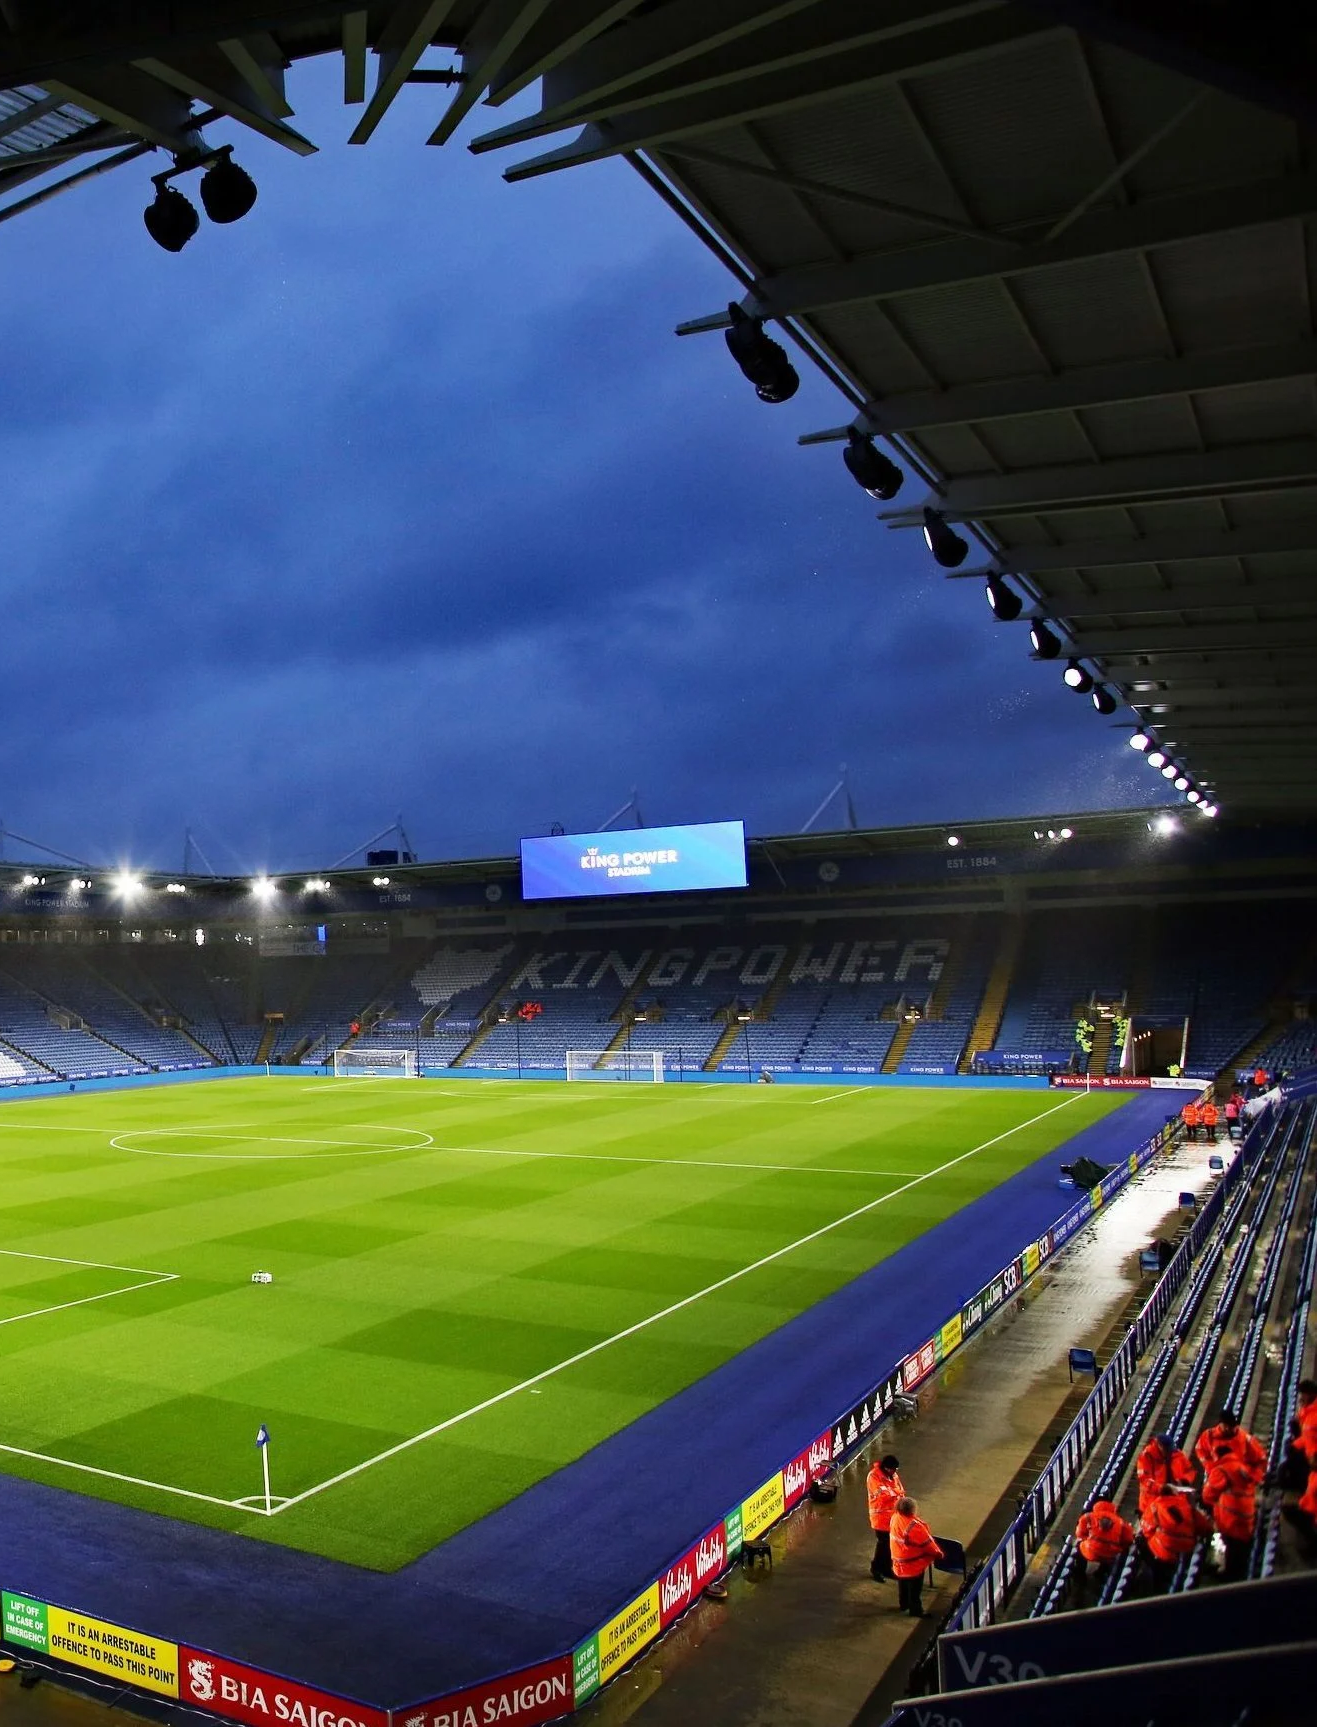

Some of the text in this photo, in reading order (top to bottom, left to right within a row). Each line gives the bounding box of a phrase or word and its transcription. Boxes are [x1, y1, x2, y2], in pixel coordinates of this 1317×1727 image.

[581, 850, 678, 869] KING POWER
[607, 866, 651, 877] STADIUM
[784, 1460, 807, 1499] Vitality
[695, 1533, 724, 1580] Vitality
[10, 1600, 40, 1617] LIFT OFF
[661, 1563, 692, 1614] Vitality
[5, 1624, 47, 1645] EMERGENCY
[7, 1611, 44, 1632] IN CASE OF
[67, 1621, 156, 1660] IT IS AN ARRESTABLE
[600, 1610, 659, 1672] OFFENCE TO PASS THIS POINT
[608, 1599, 651, 1645] IT IS AN ARRESTABLE
[51, 1634, 175, 1685] OFFENCE TO PASS THIS POINT
[220, 1674, 269, 1715] BIA
[483, 1673, 567, 1725] SAIGON
